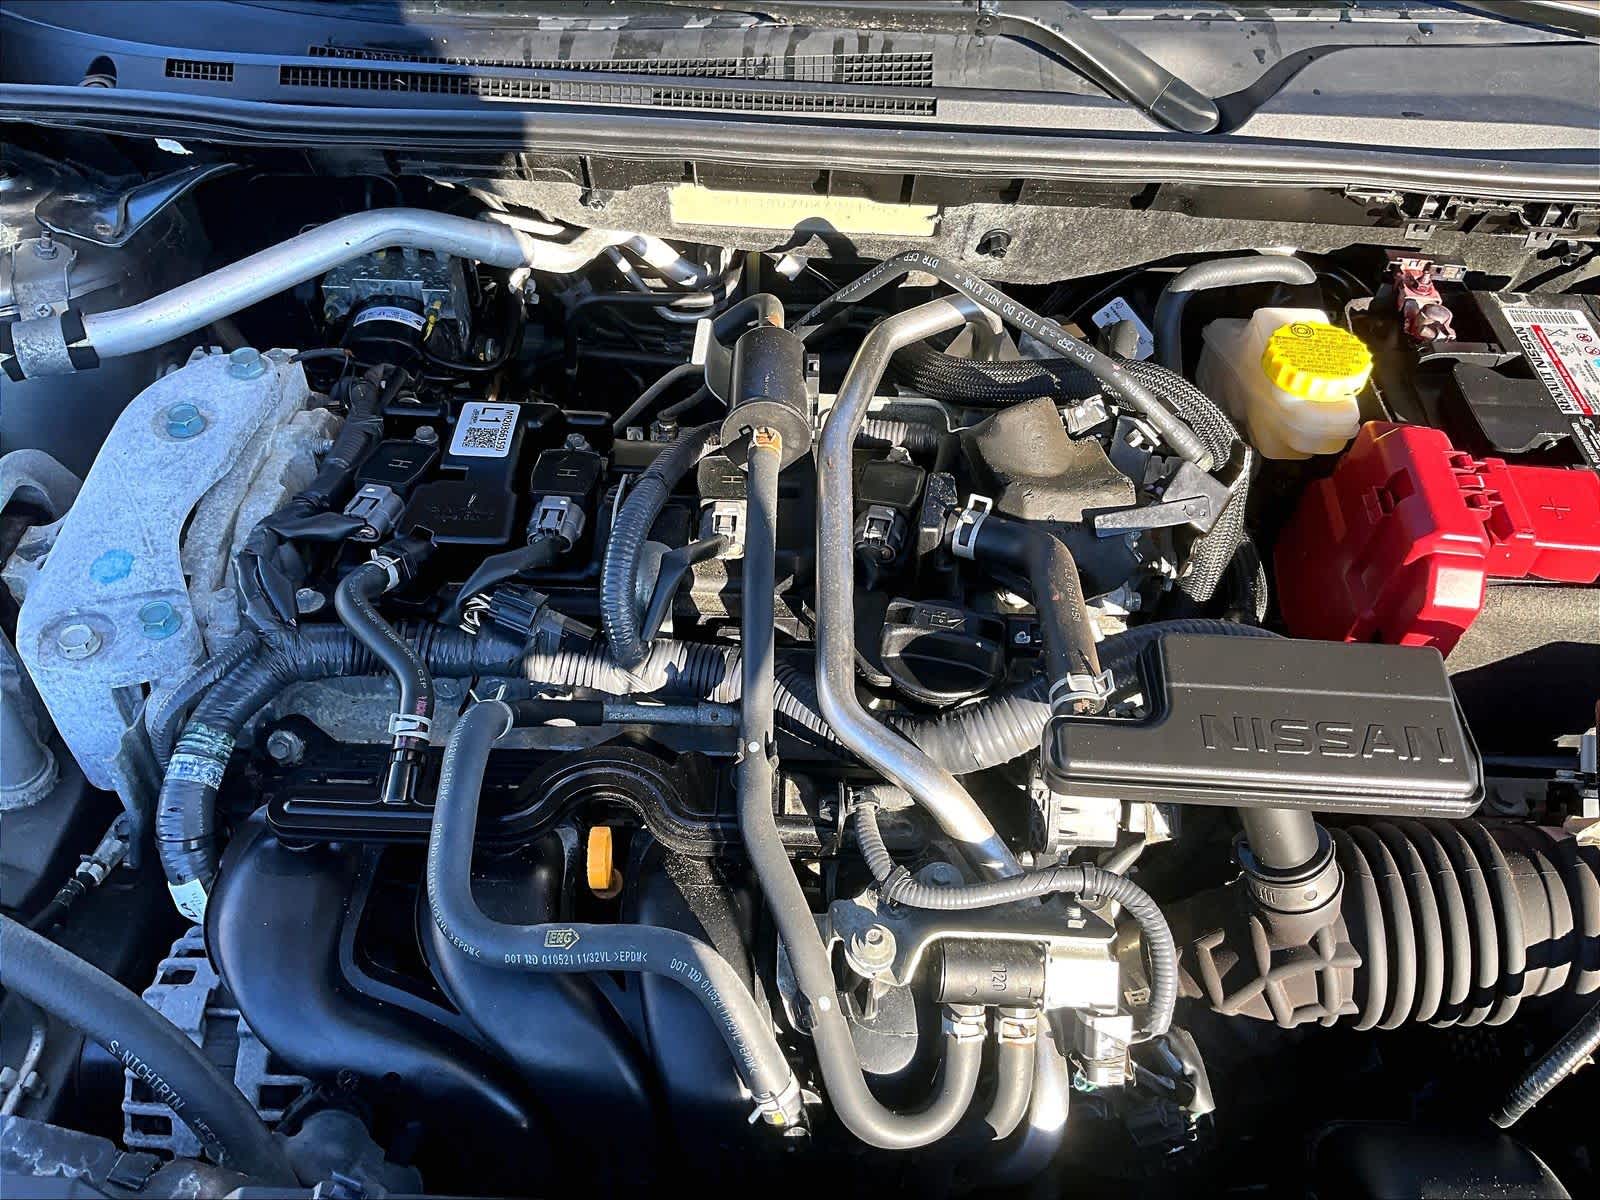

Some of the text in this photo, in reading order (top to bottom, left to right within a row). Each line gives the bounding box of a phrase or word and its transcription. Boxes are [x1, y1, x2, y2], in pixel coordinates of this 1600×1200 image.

[962, 276, 985, 292] KINK
[984, 290, 1002, 307] NOT
[1002, 302, 1016, 316] DO
[1016, 311, 1038, 329] 1713
[1513, 325, 1550, 370] NISSAN
[1540, 367, 1573, 411] RENAULT
[479, 407, 505, 422] L1
[1199, 713, 1455, 763] NISSAN
[504, 953, 521, 964] DOT
[670, 958, 688, 974] DOT
